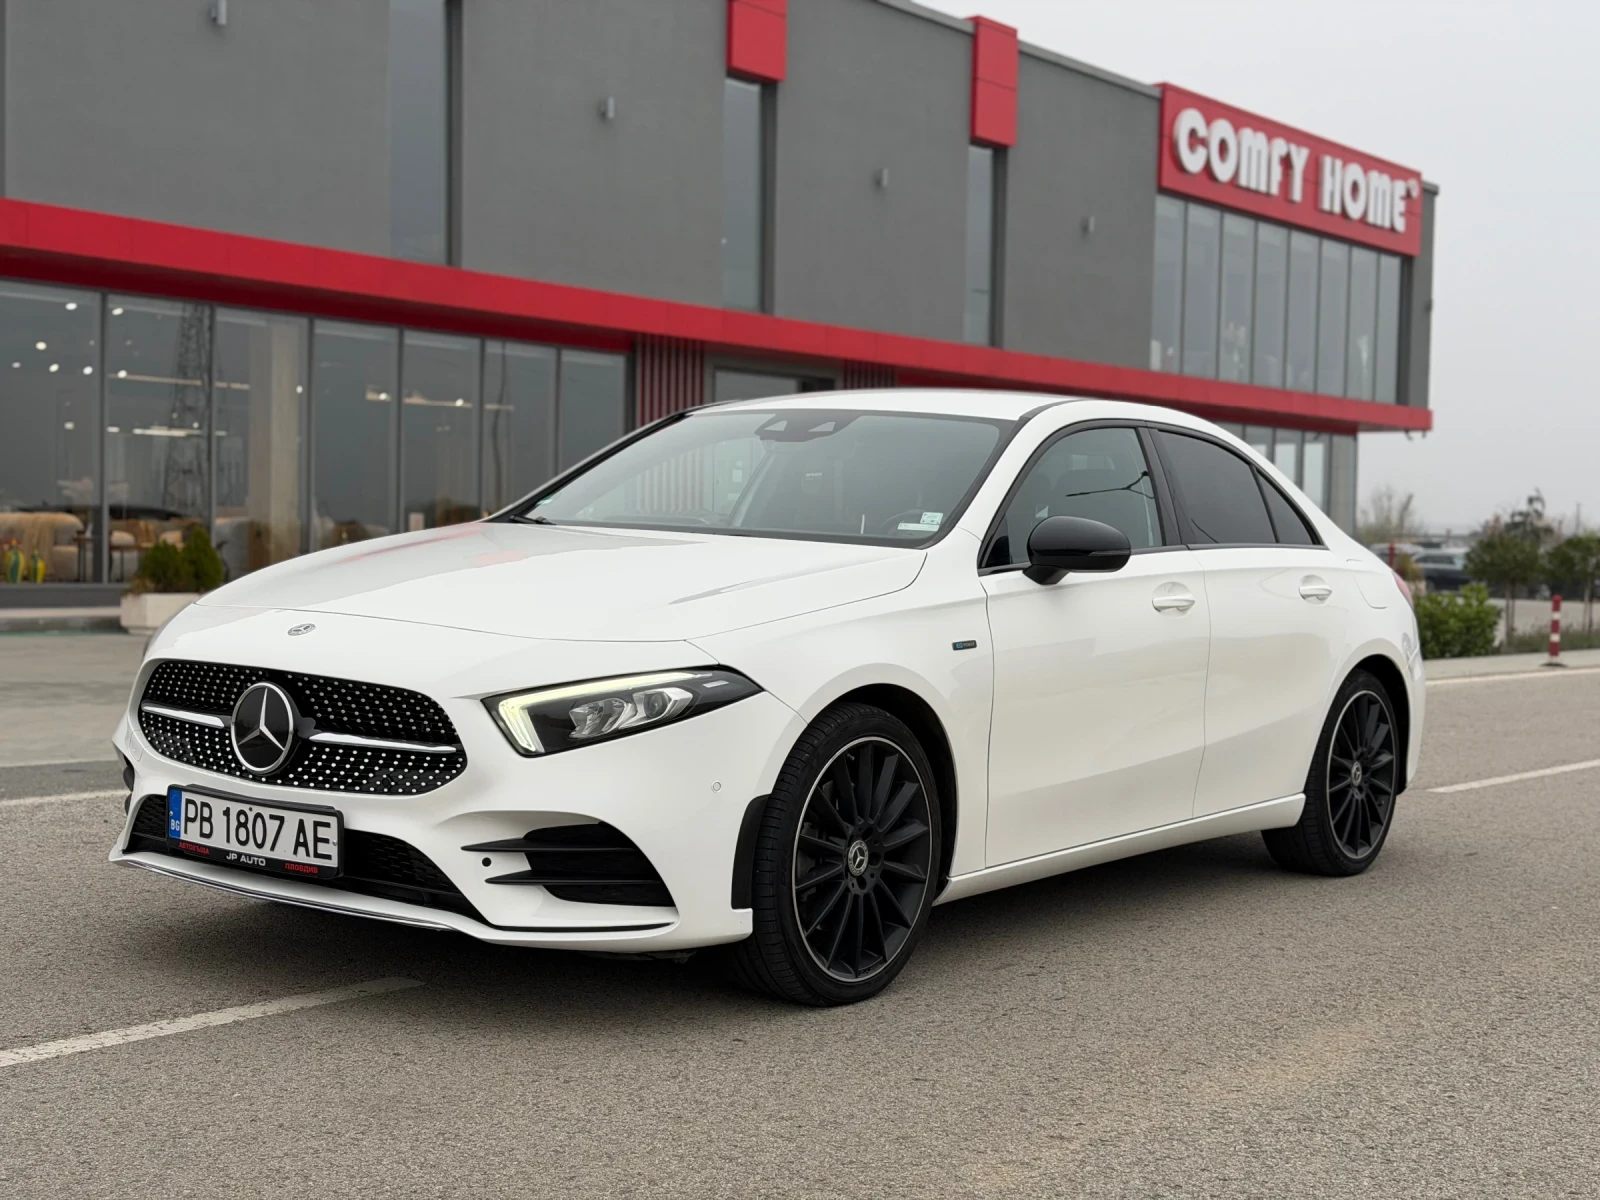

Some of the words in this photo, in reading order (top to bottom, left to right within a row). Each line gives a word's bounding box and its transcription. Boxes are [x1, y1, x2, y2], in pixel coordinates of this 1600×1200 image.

[1174, 107, 1309, 203] COMFY
[1320, 154, 1406, 233] HOME
[170, 819, 180, 831] BG
[184, 798, 213, 839] PB
[222, 806, 285, 851] 1807
[293, 818, 332, 860] AE
[179, 842, 209, 854] АВТОКЪЩА
[226, 852, 238, 861] JP
[240, 856, 265, 866] AUTO
[285, 863, 318, 873] ПЛОВДИВ
